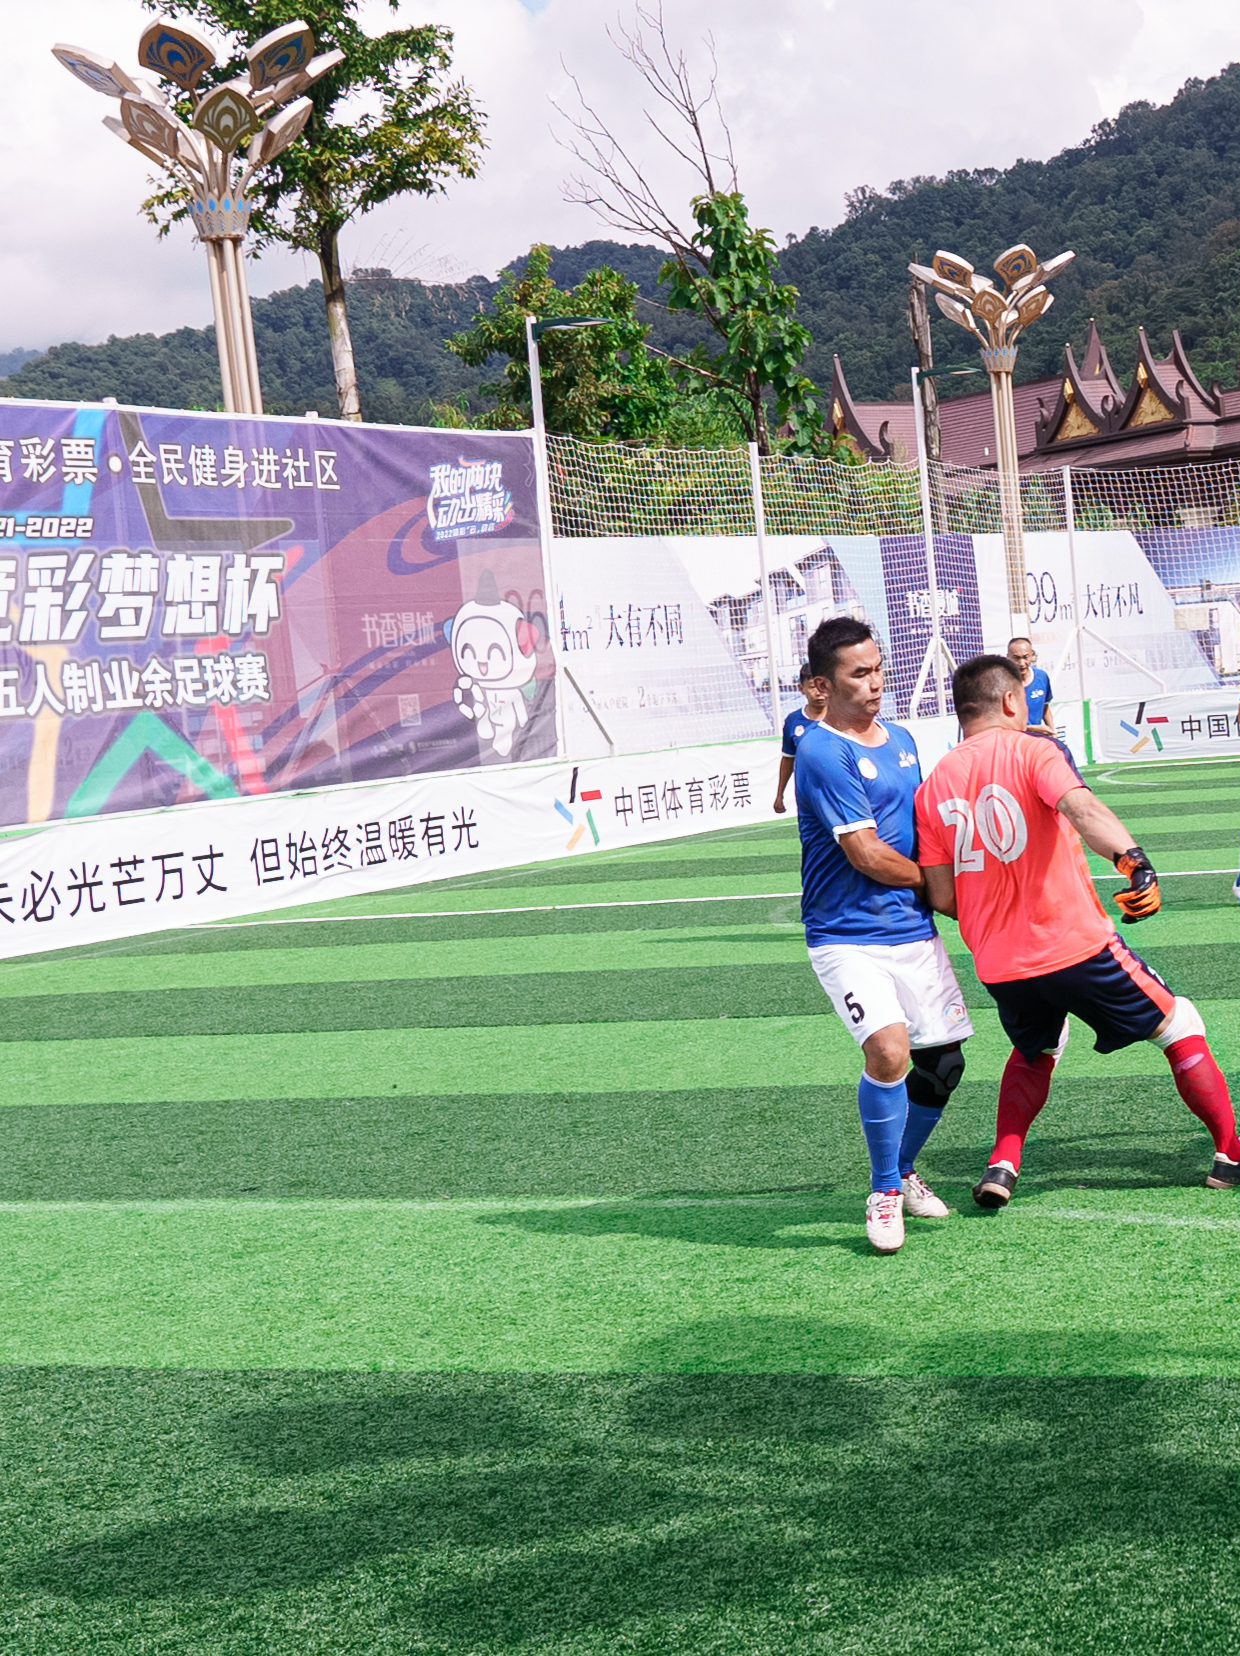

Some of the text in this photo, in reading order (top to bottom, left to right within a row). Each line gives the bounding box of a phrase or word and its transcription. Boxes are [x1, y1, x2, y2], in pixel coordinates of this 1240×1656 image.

[0, 552, 285, 642] 彩梦想杯
[603, 603, 684, 650] 大有不同
[1082, 582, 1144, 619] 大有不凡
[0, 653, 271, 717] 五人制业余足球赛
[250, 806, 480, 886] 但始终温暖有光
[614, 771, 752, 827] 中国体育彩票
[937, 783, 1027, 877] 20
[844, 991, 866, 1024] 5
